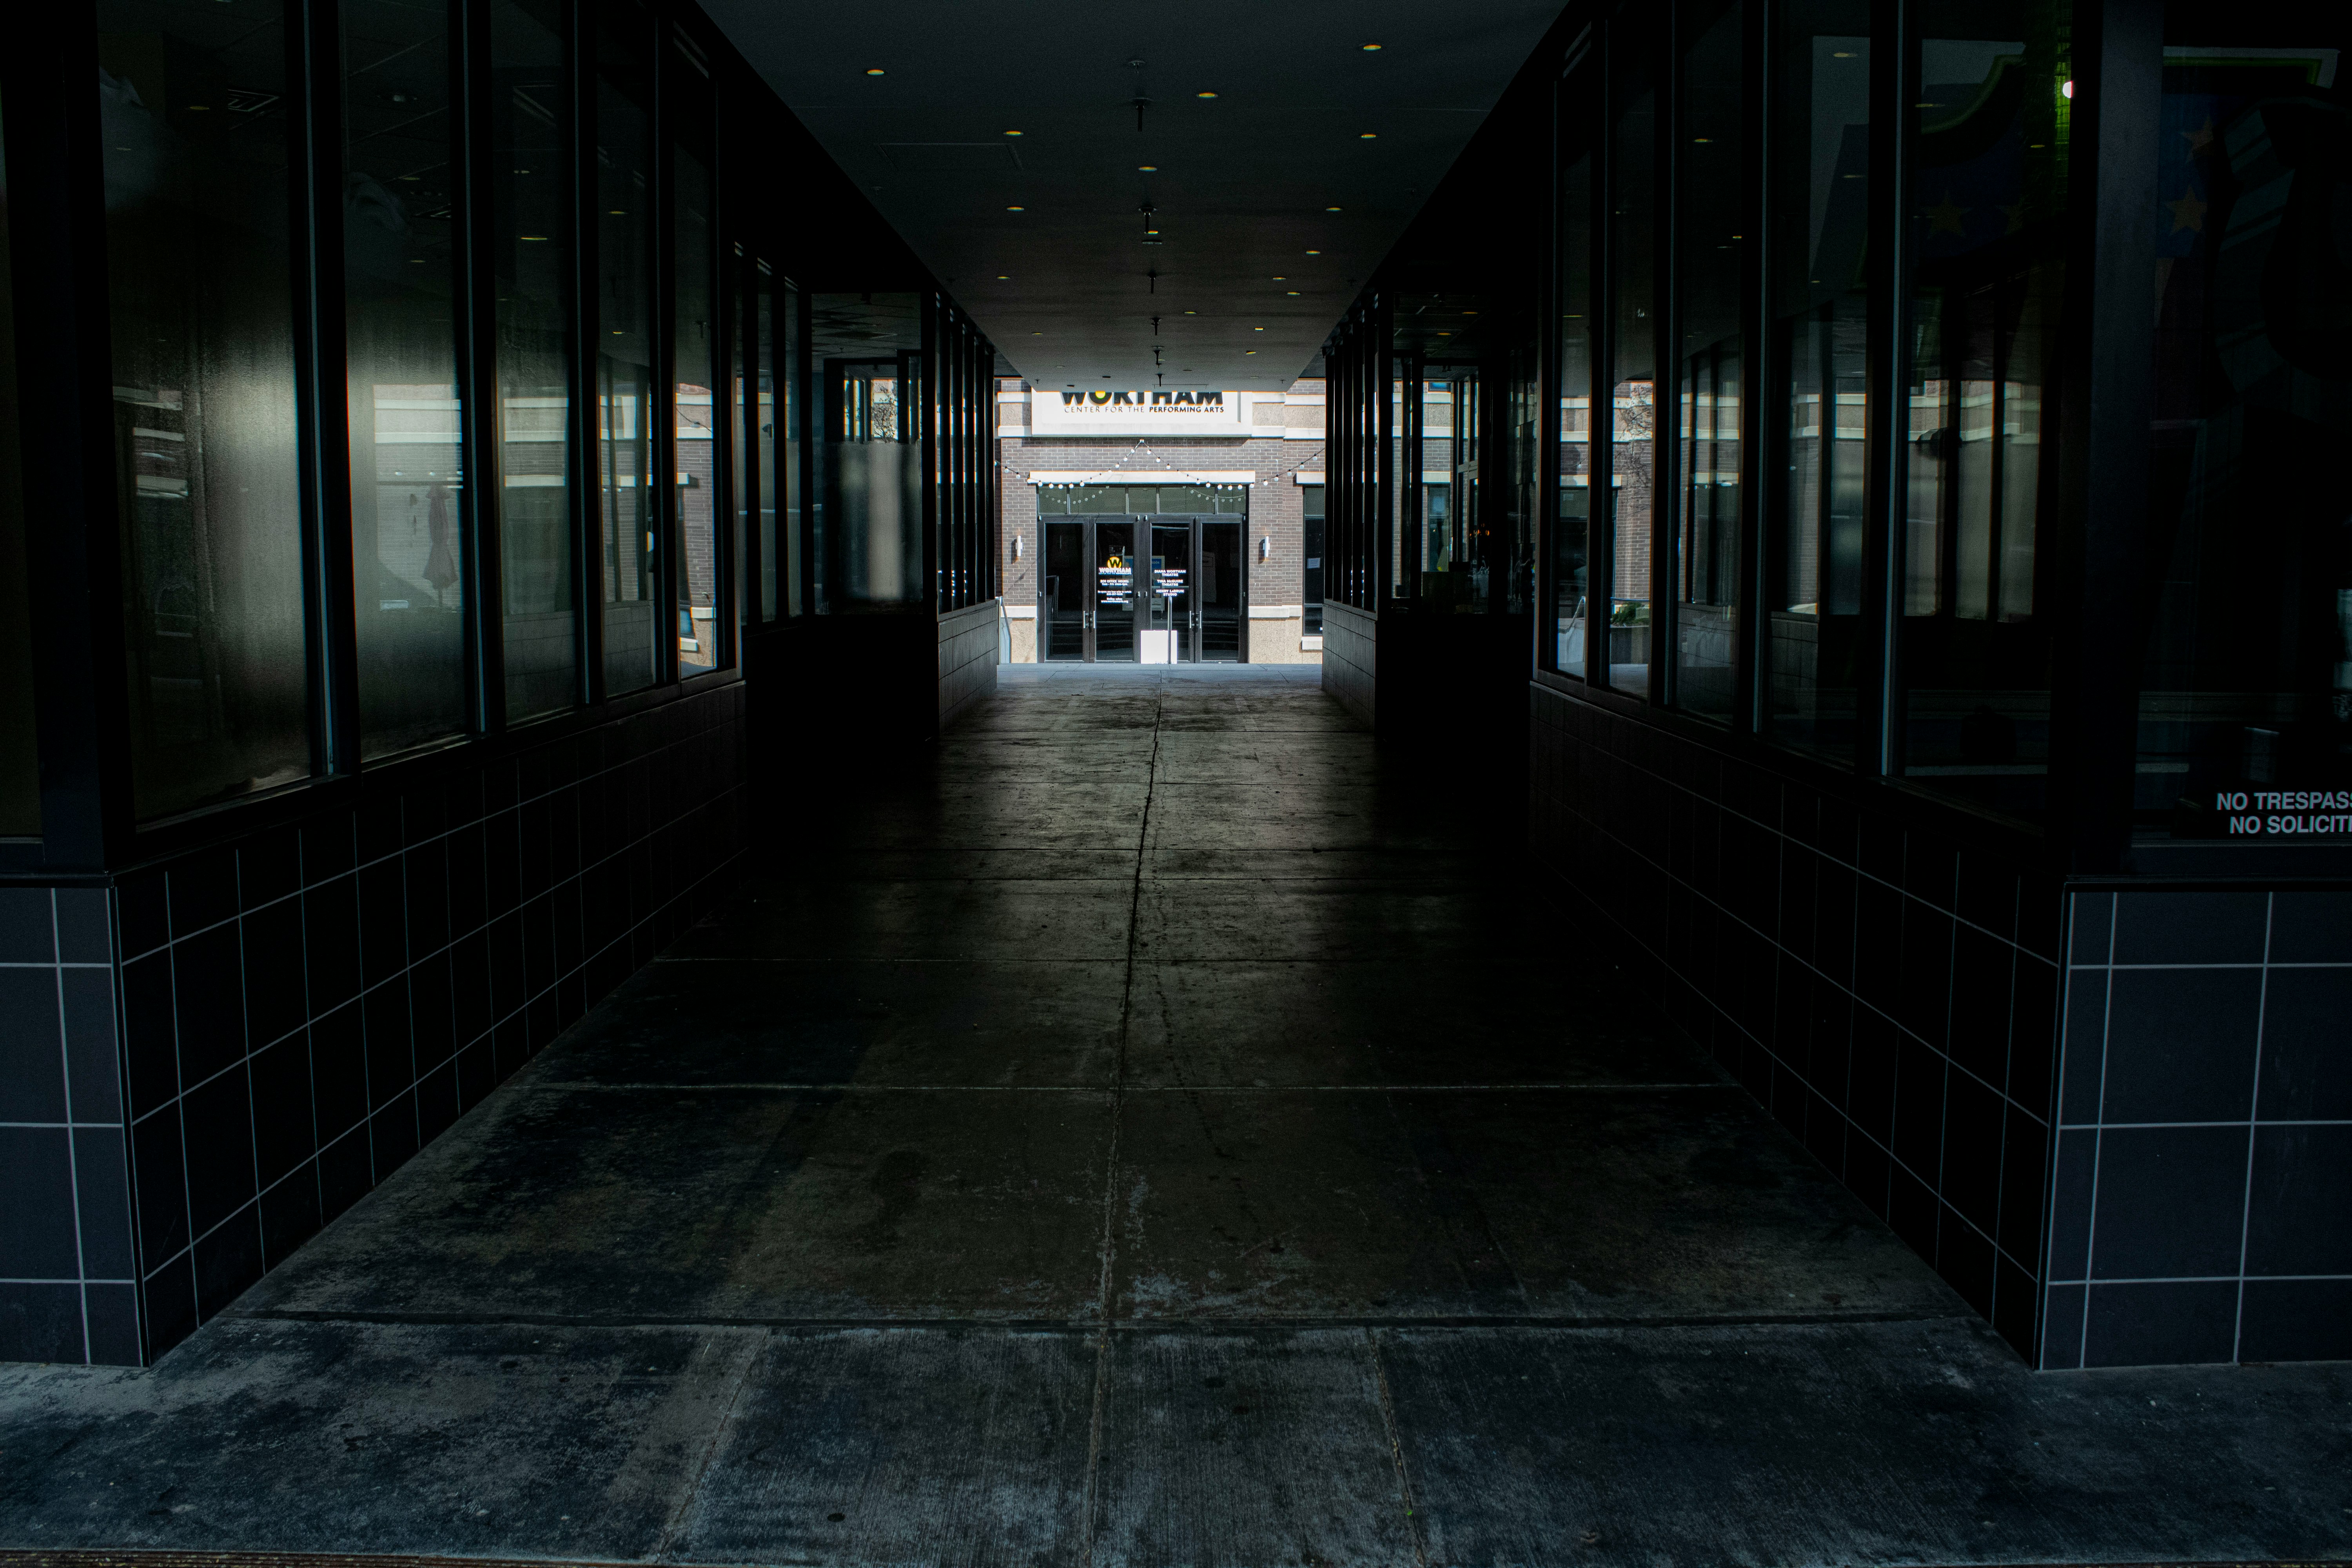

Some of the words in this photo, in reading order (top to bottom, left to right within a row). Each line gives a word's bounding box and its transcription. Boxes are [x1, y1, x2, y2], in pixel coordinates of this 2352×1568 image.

[2217, 792, 2249, 810] NO
[2254, 791, 2352, 809] TRESPAS
[2230, 816, 2261, 834] NO
